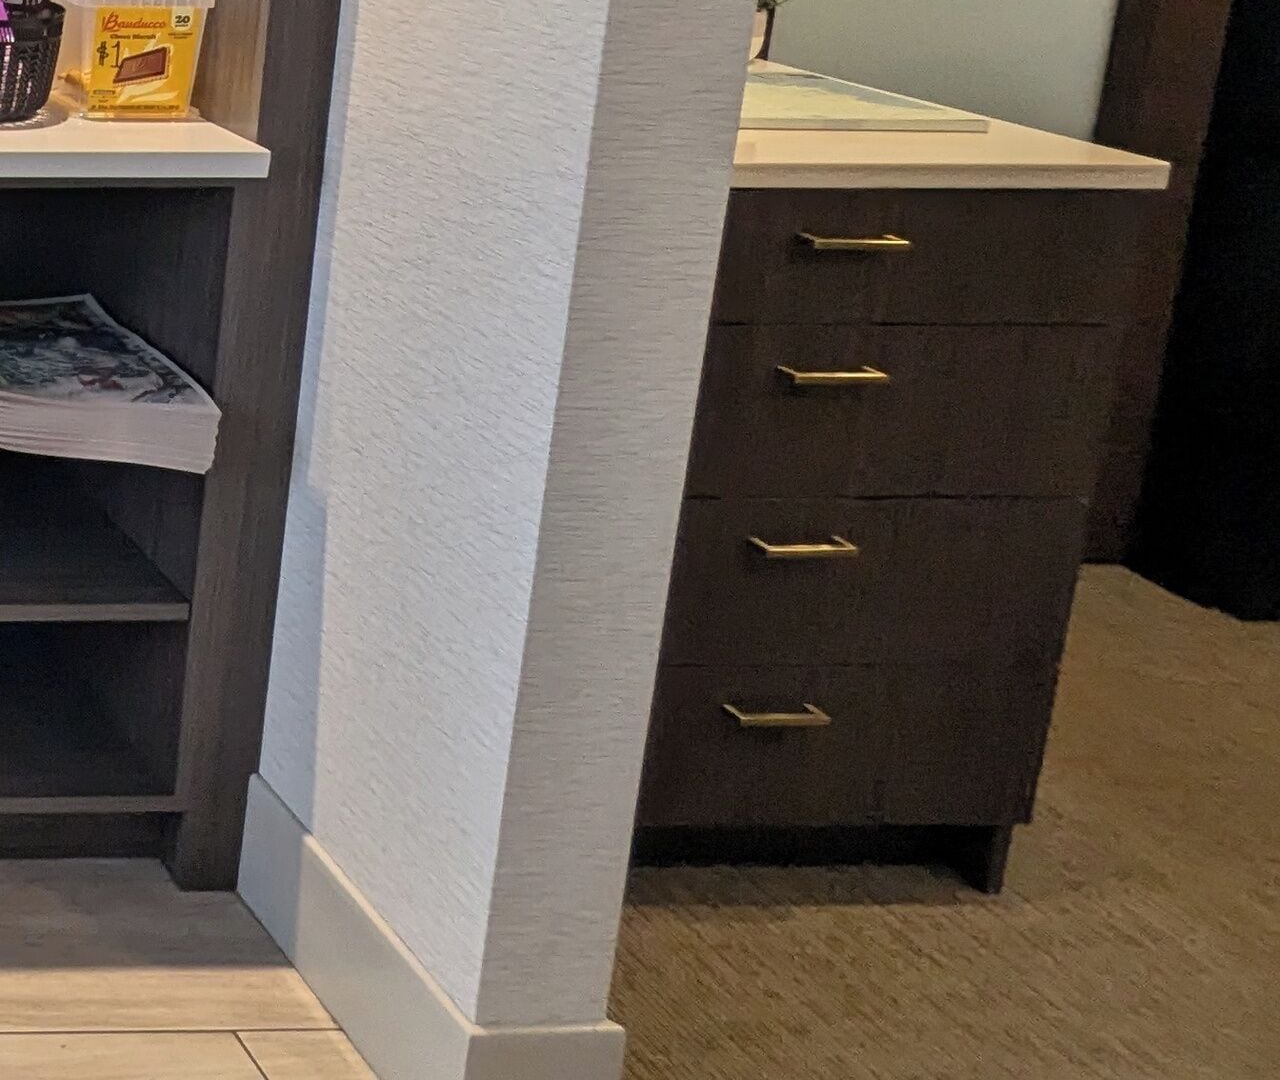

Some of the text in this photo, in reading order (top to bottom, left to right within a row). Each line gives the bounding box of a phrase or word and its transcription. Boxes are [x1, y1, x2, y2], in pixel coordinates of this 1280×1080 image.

[102, 12, 167, 32] Bauducco
[175, 15, 191, 24] 20
[96, 40, 121, 69] $1
